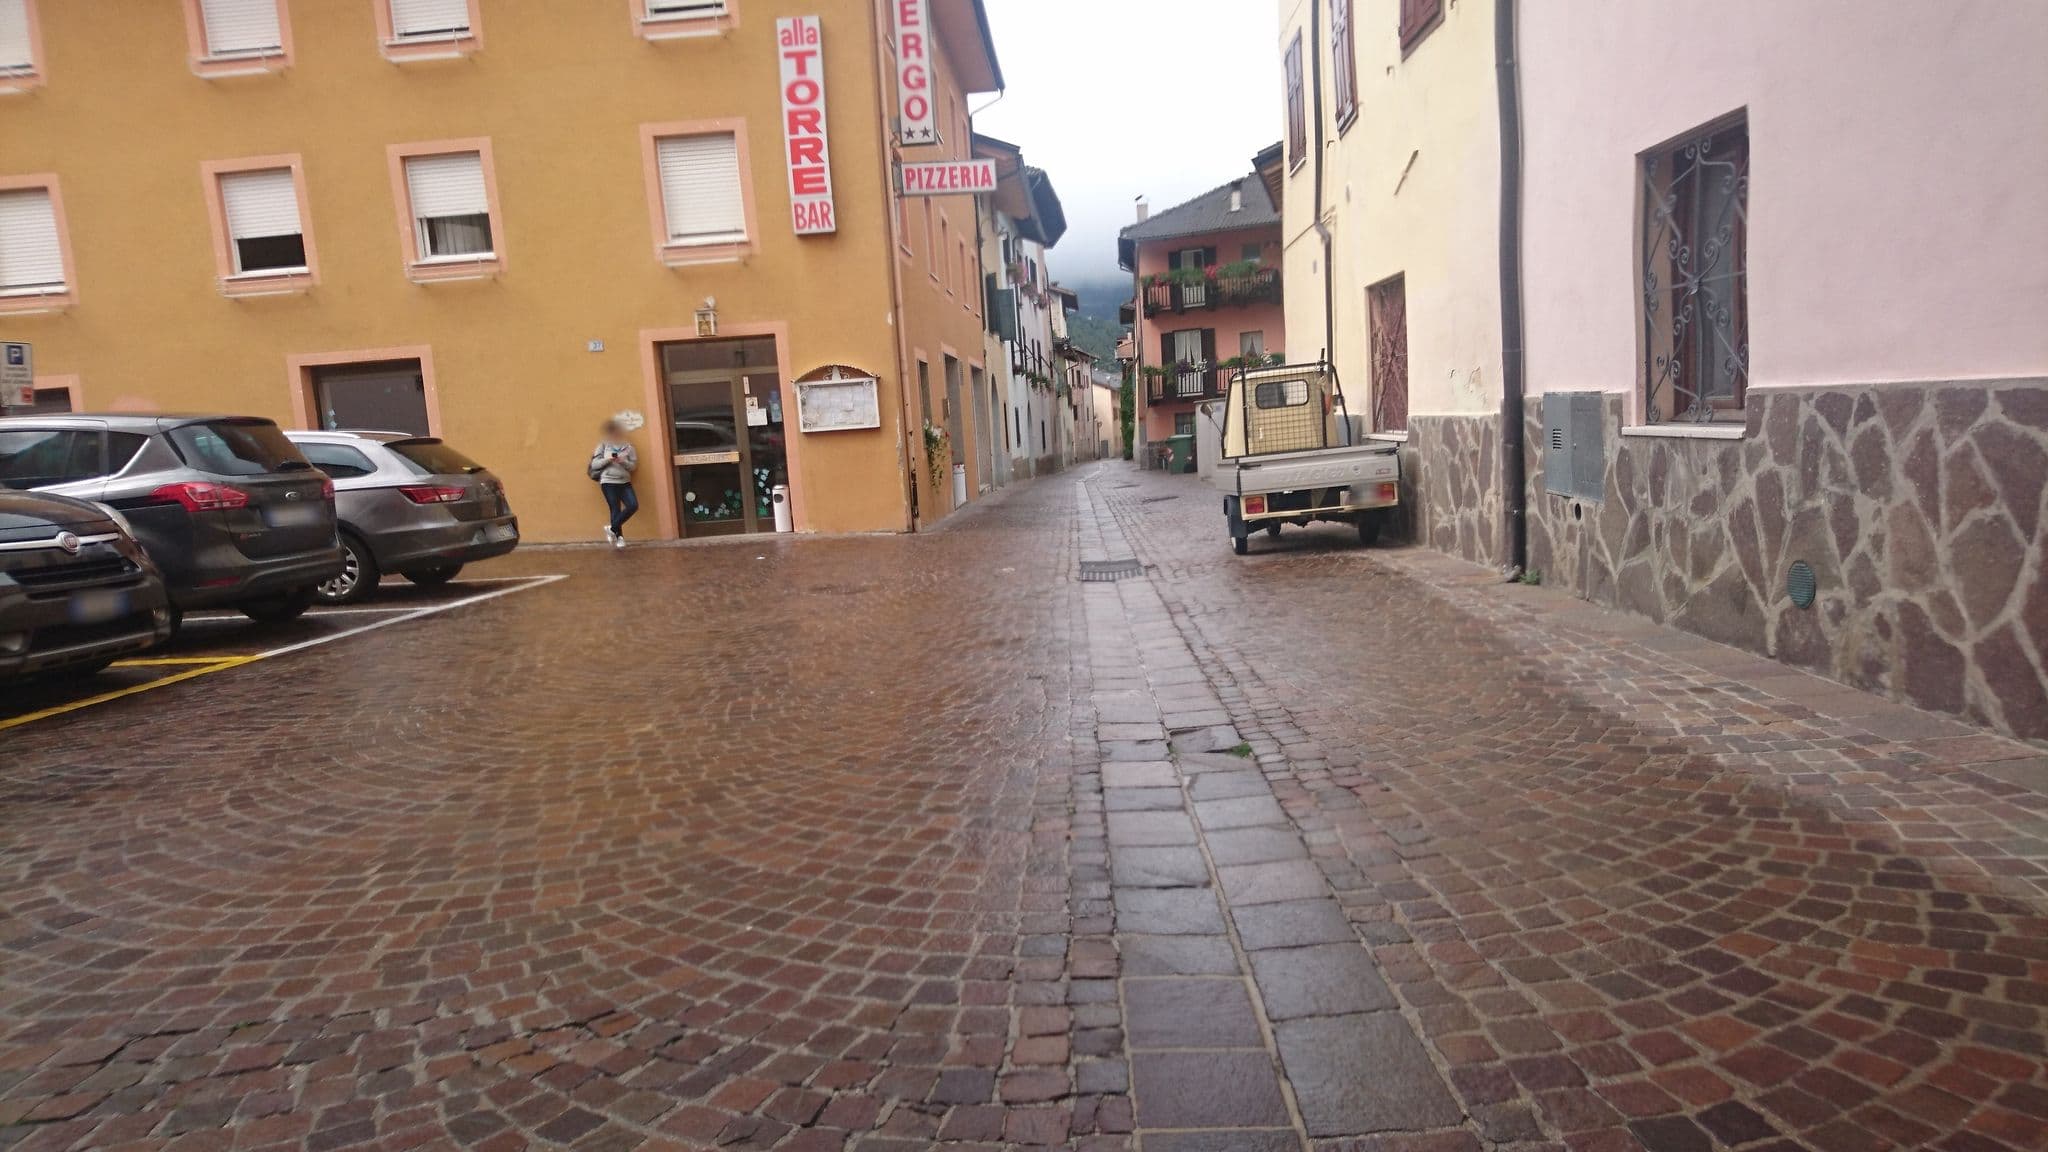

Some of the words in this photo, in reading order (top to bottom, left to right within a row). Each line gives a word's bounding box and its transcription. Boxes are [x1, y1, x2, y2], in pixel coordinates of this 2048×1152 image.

[781, 18, 818, 46] alla
[784, 51, 827, 195] TORRE
[905, 165, 992, 190] PIZZERIA
[794, 201, 833, 230] BAR
